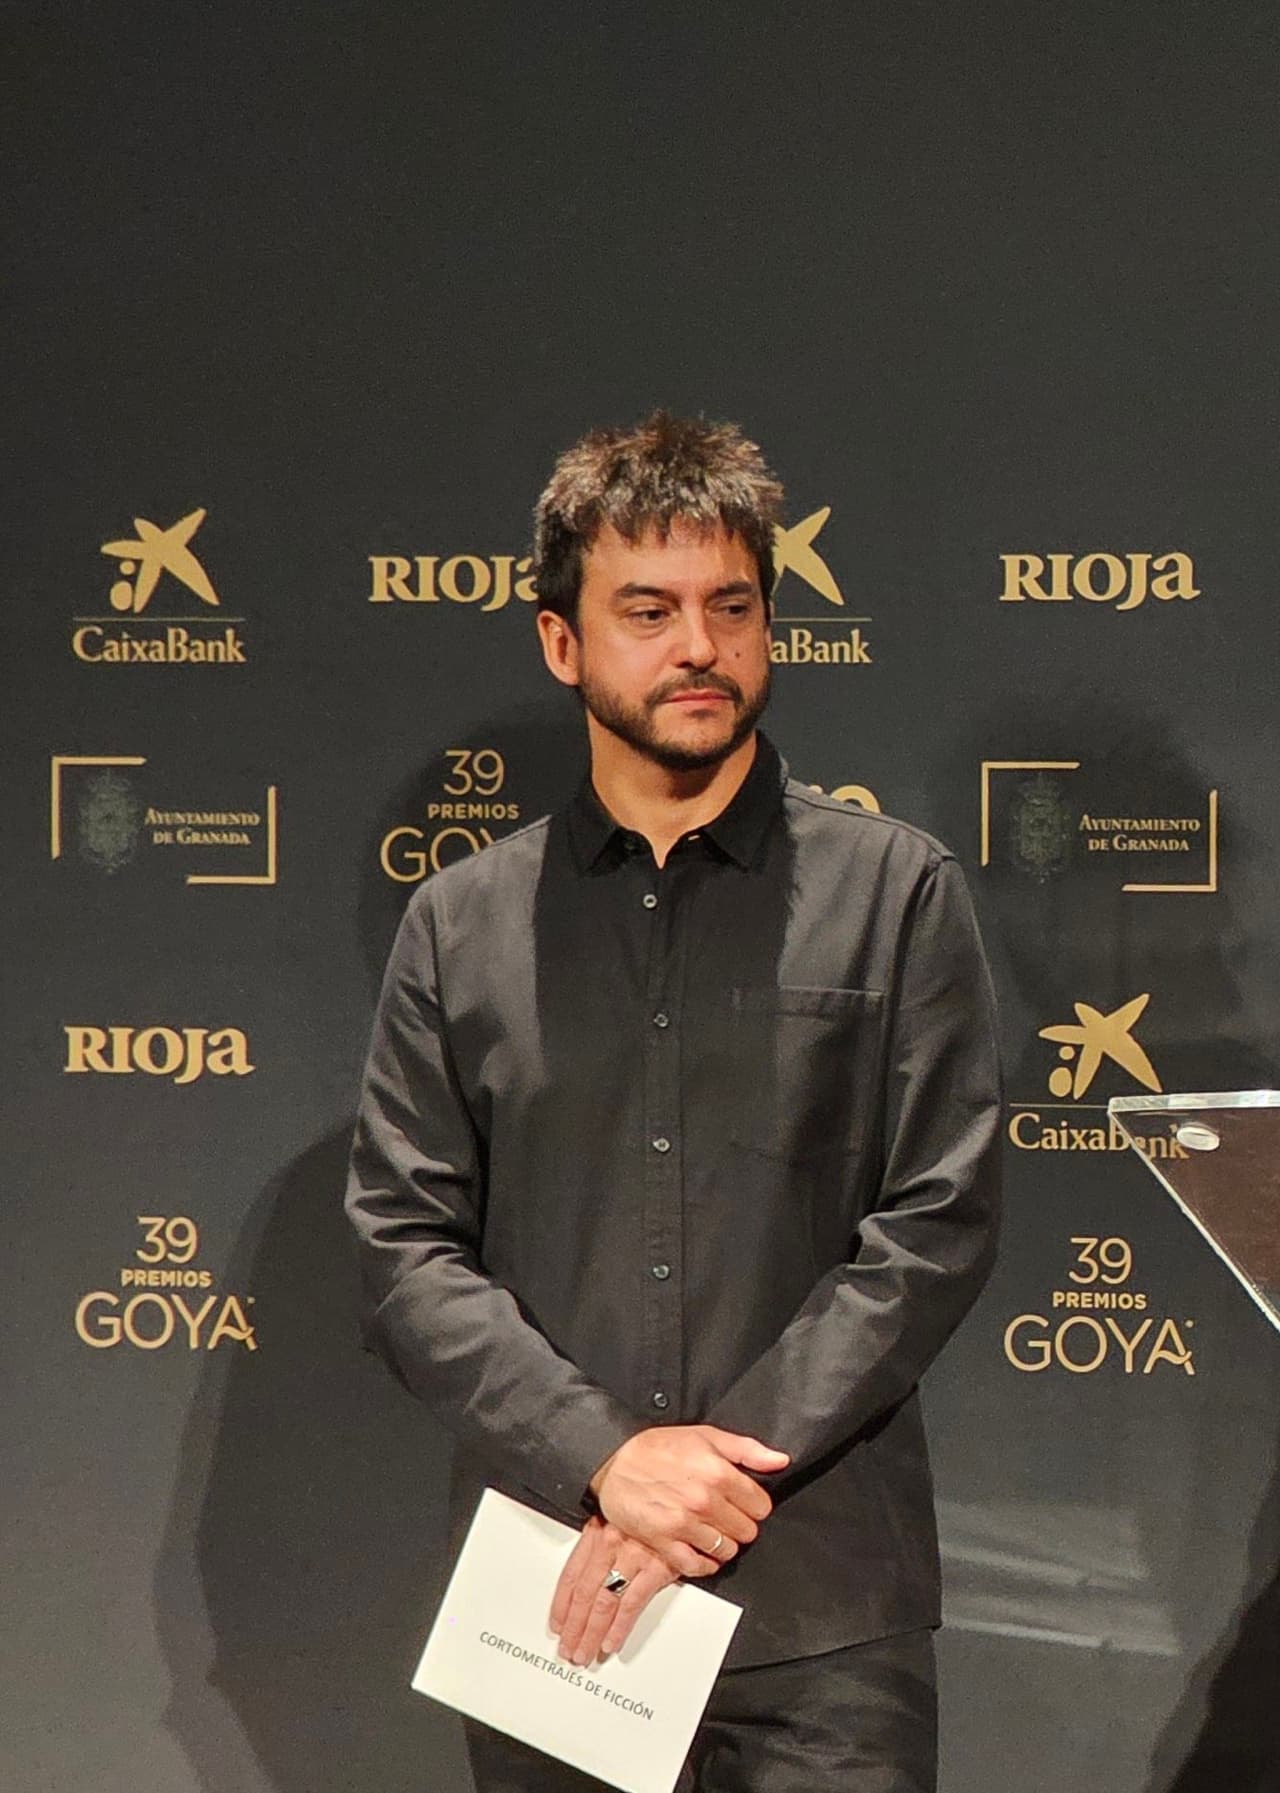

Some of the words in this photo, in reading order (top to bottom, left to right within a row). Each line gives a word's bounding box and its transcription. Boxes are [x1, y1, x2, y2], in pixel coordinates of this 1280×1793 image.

[72, 626, 247, 664] CaixaBank
[771, 627, 873, 664] aBank
[443, 749, 505, 796] 39
[427, 803, 520, 820] PREMIOS
[136, 1216, 198, 1265] 39
[1070, 1236, 1133, 1285] 39
[120, 1269, 213, 1288] PREMIOS
[1052, 1291, 1148, 1311] PREMIOS
[74, 1293, 259, 1352] GOYA
[1003, 1314, 1196, 1376] GOYA
[479, 1630, 583, 1688] CORTOMETRAJES
[585, 1680, 602, 1697] DE
[603, 1688, 655, 1721] FICCIÓN
